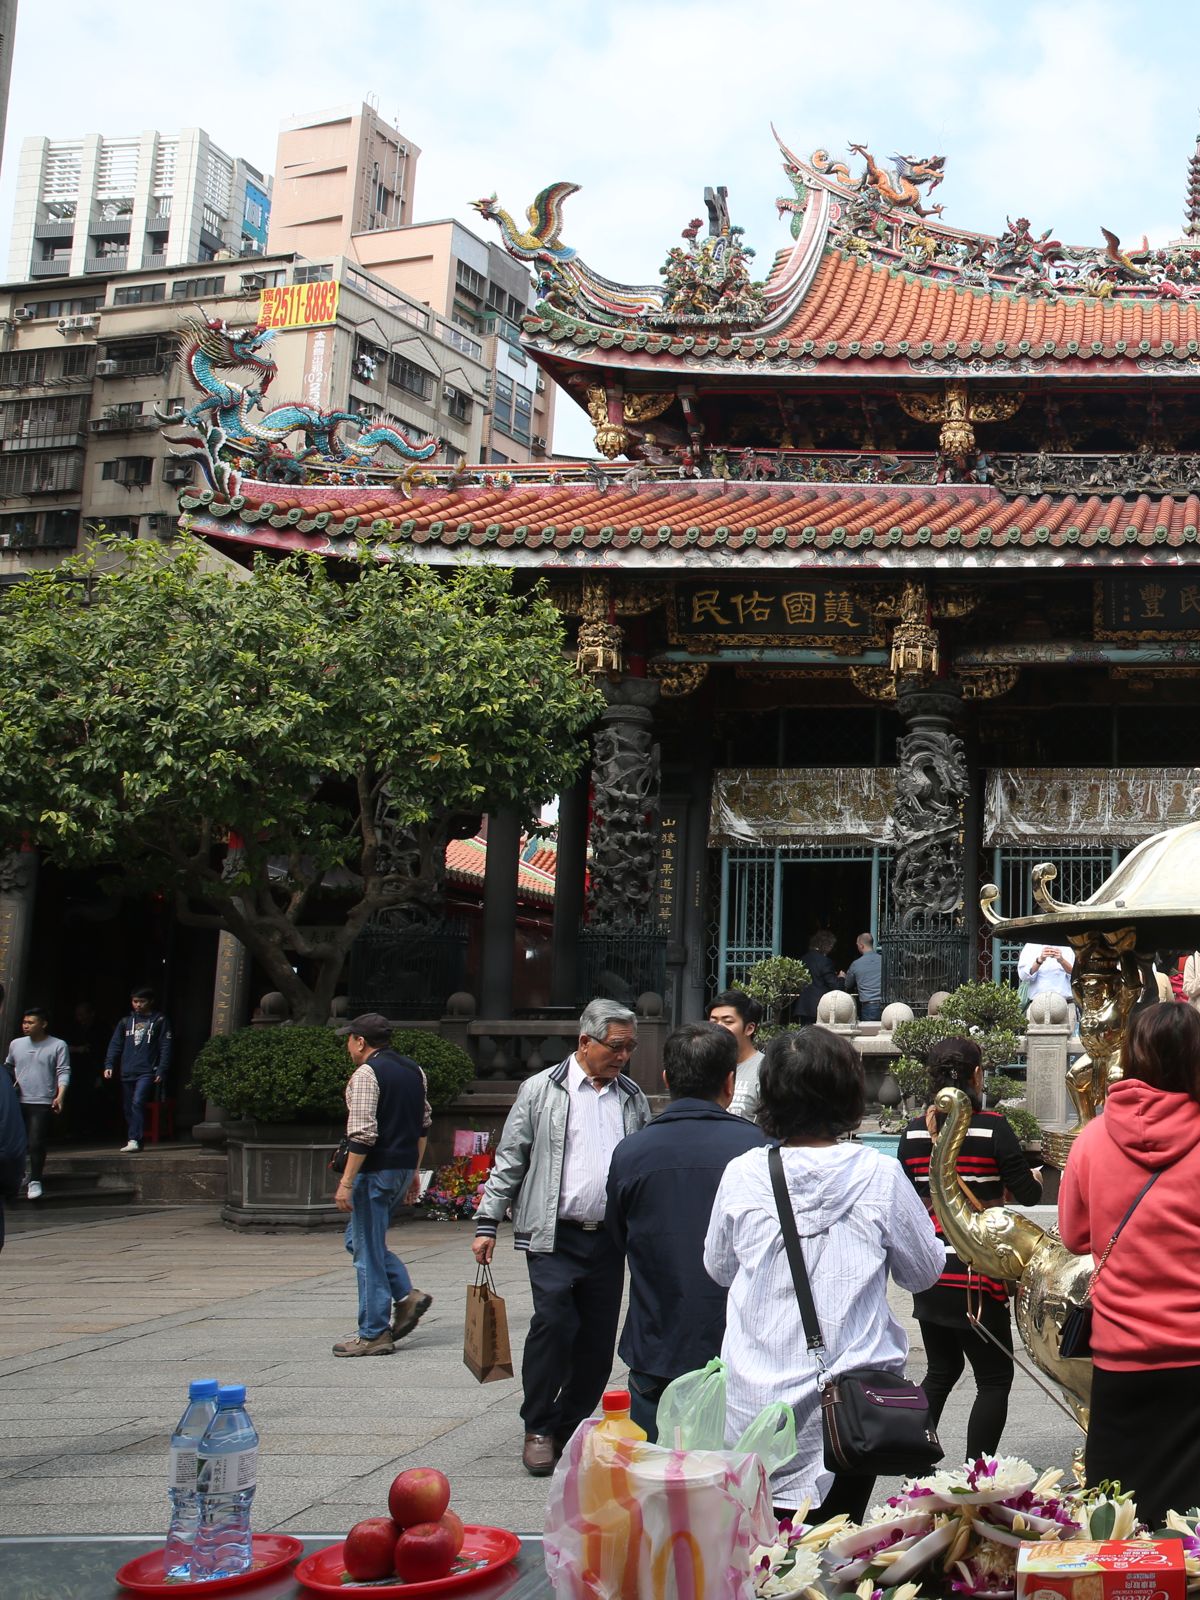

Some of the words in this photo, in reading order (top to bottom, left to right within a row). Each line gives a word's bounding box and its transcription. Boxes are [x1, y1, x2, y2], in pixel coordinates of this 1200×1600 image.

[272, 280, 336, 327] 2511-8883
[691, 589, 862, 628] 護國佑民
